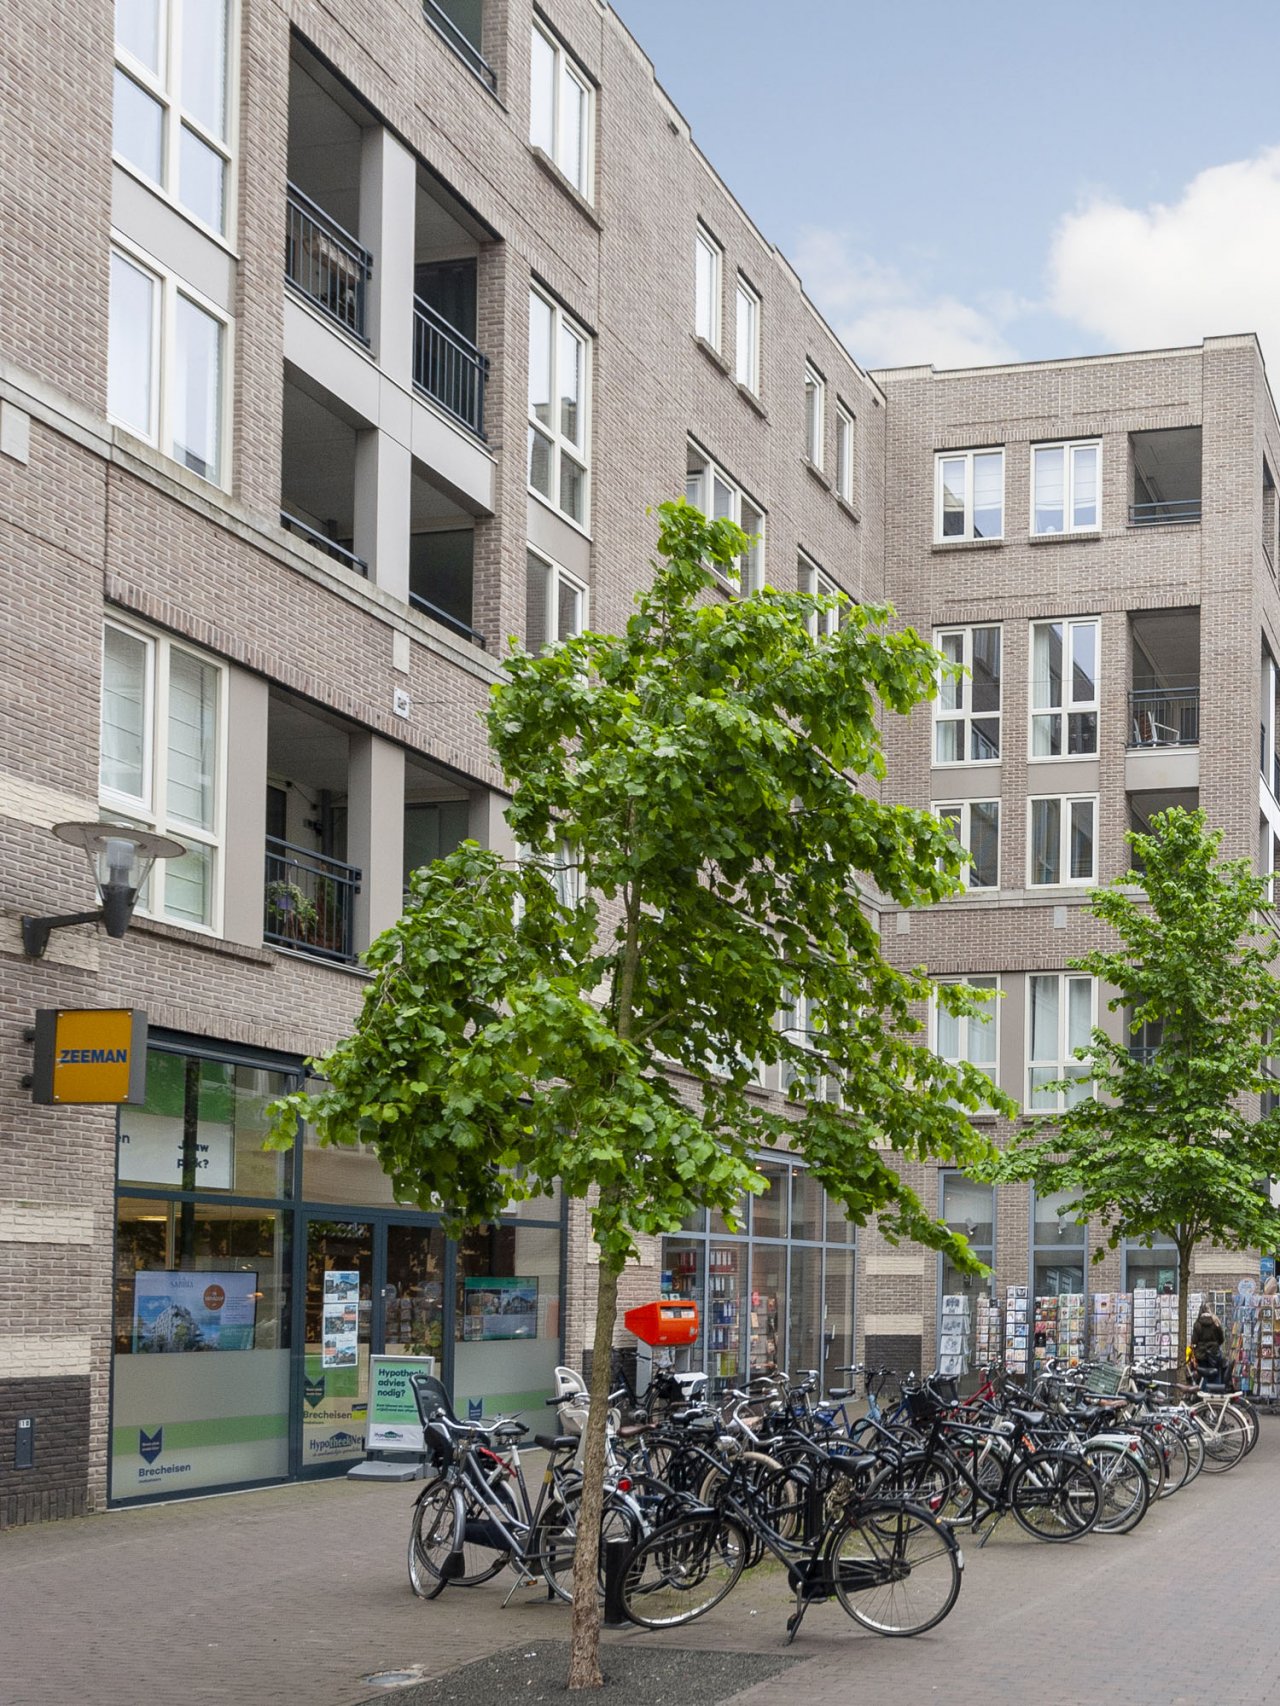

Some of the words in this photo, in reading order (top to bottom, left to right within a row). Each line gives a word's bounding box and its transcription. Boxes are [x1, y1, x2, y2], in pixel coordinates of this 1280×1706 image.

[59, 1049, 127, 1064] ZEEMAN
[377, 1379, 406, 1387] advies
[377, 1389, 406, 1399] nodig?
[303, 1410, 352, 1420] Brecheisen
[138, 1464, 192, 1478] Brecheisen
